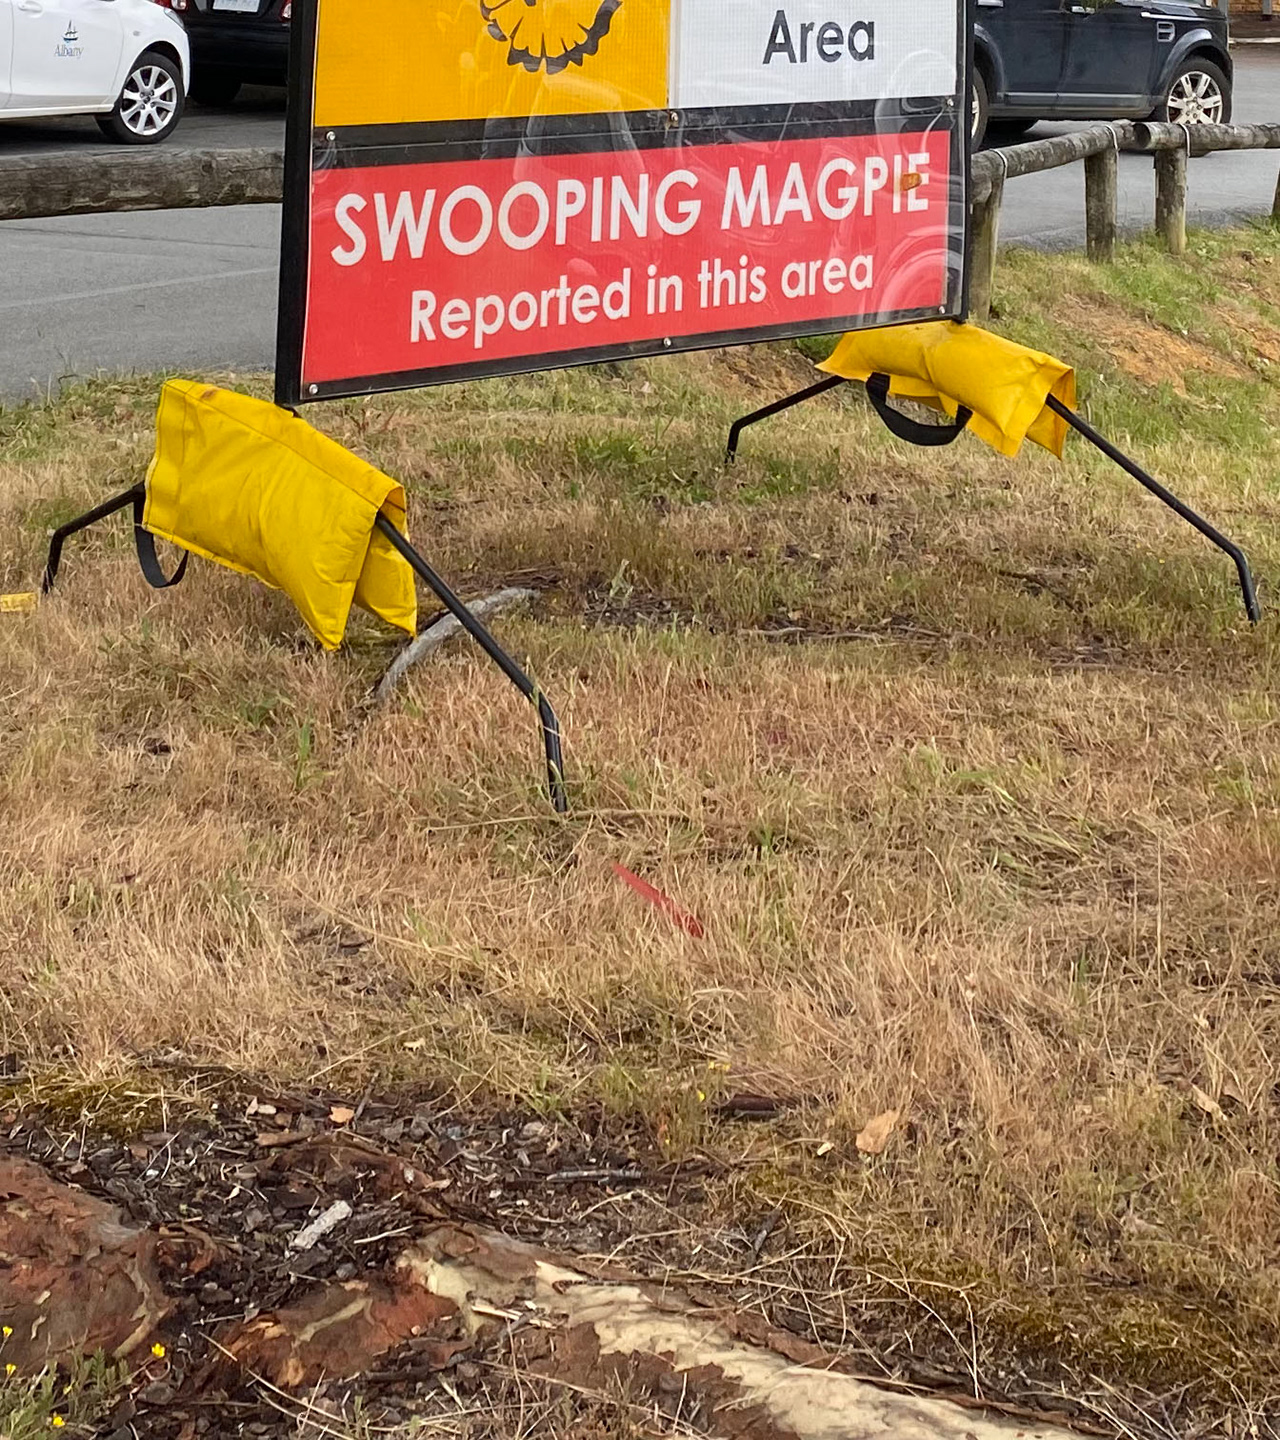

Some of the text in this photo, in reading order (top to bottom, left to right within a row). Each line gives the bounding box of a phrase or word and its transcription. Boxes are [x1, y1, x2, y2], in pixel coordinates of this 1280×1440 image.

[53, 44, 84, 59] Albany
[762, 9, 875, 65] Area
[331, 152, 930, 267] SWOOPING MAGPIE
[410, 255, 874, 349] Reported in this area
